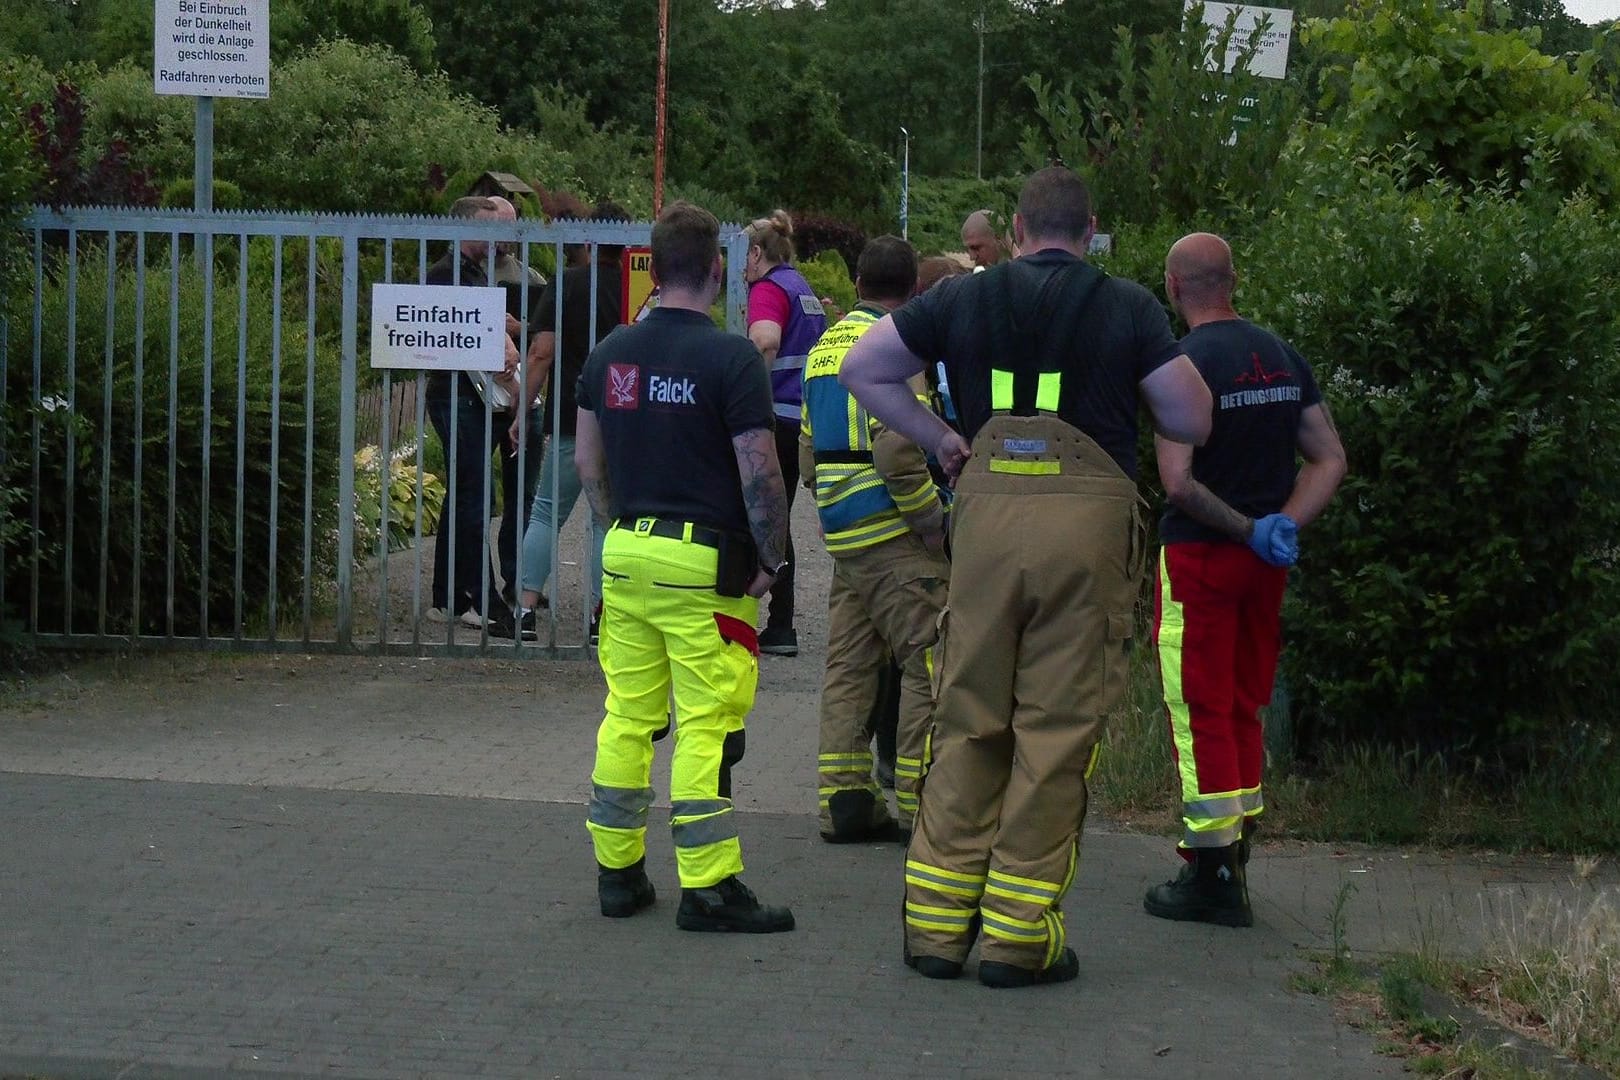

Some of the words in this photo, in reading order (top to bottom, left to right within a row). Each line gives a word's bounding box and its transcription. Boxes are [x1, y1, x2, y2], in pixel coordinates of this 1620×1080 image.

[179, 1, 197, 13] Bei
[199, 2, 247, 16] Einbruch
[174, 16, 192, 28] der
[195, 17, 252, 32] Dunkelheit
[172, 33, 196, 44] wird
[198, 34, 215, 45] die
[217, 35, 254, 49] Anlage
[1278, 31, 1288, 39] ist
[178, 49, 248, 62] geschlossen.
[160, 69, 215, 83] Radfahren
[218, 73, 264, 86] verboten
[396, 305, 481, 324] Einfahrt
[648, 375, 697, 405] Falck
